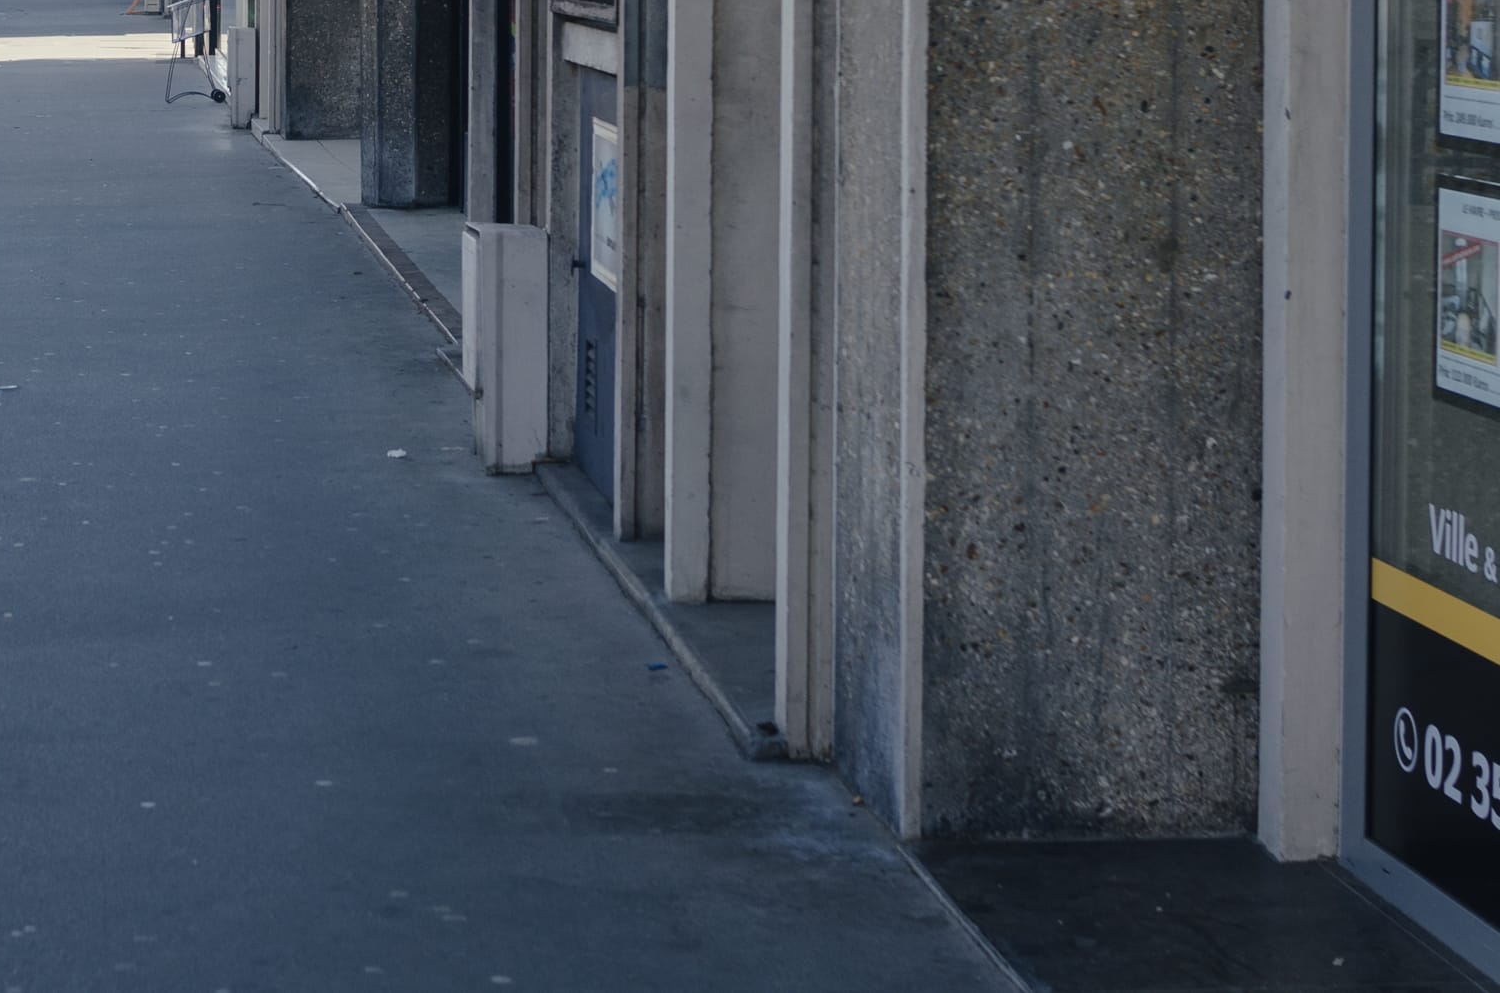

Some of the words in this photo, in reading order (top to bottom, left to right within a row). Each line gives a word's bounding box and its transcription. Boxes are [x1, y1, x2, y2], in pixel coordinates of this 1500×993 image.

[1428, 502, 1479, 574] Ville
[1484, 546, 1498, 584] &
[1424, 724, 1462, 805] 02
